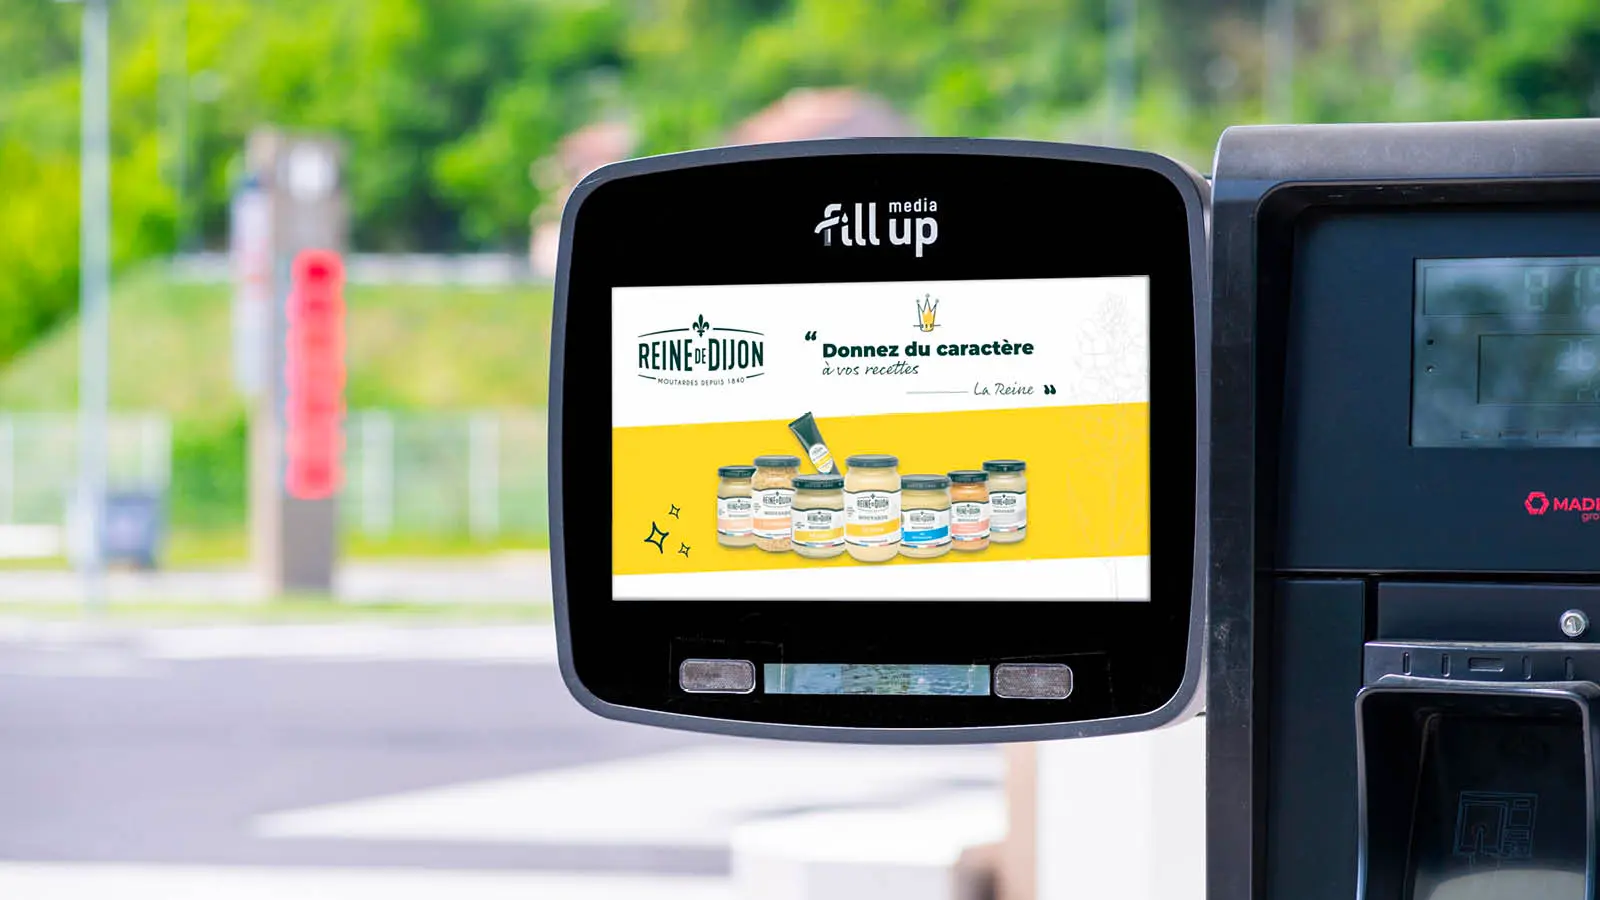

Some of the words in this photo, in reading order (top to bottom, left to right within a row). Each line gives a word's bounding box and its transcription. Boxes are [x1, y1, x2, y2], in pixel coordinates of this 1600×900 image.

[889, 197, 938, 213] media
[814, 202, 880, 247] fill
[889, 216, 938, 258] up
[638, 339, 693, 371] REINE
[694, 347, 707, 364] DE
[708, 338, 764, 372] DIJON
[823, 343, 900, 358] Donnez
[904, 341, 931, 357] du
[936, 338, 1035, 357] caractère
[822, 360, 835, 376] à
[836, 365, 860, 376] vos
[864, 360, 919, 376] recettes
[657, 378, 699, 387] MOUTARDES
[700, 379, 725, 387] DEPUIS
[727, 376, 746, 385] 1840
[973, 381, 991, 396] La
[994, 380, 1035, 396] Reine
